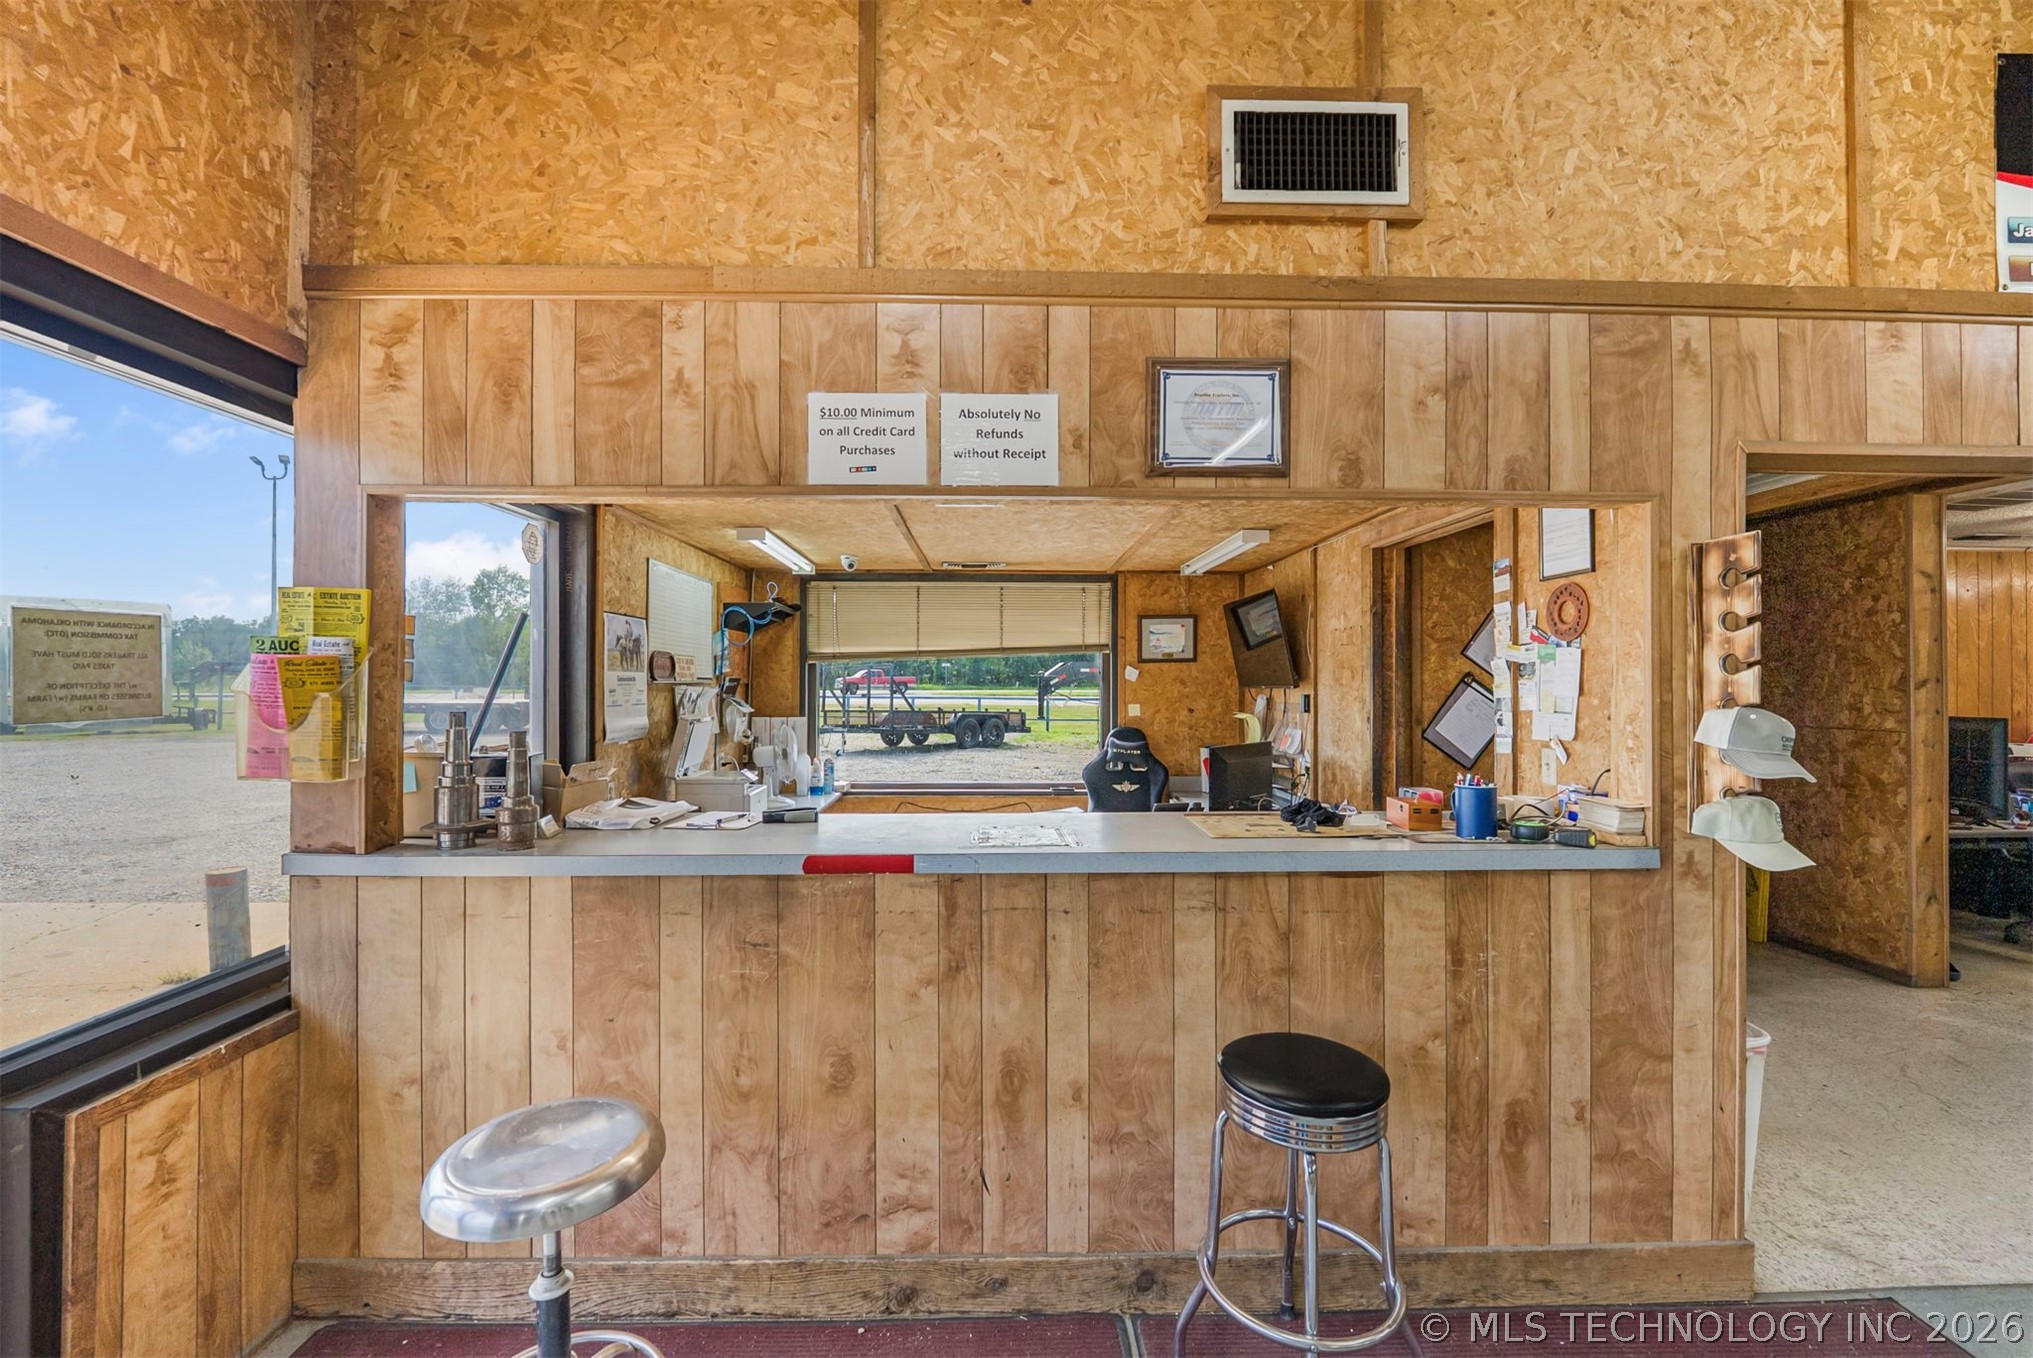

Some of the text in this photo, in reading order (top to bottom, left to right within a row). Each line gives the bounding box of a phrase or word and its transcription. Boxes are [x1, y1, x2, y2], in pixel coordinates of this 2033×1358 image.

[820, 407, 915, 420] $10.00 Minimum
[959, 408, 1041, 422] Absolutely No
[819, 426, 915, 436] on all Credit Card
[976, 428, 1024, 439] Refunds
[840, 445, 896, 455] Purchases
[954, 448, 1047, 461] without Receipt
[256, 639, 265, 651] 2
